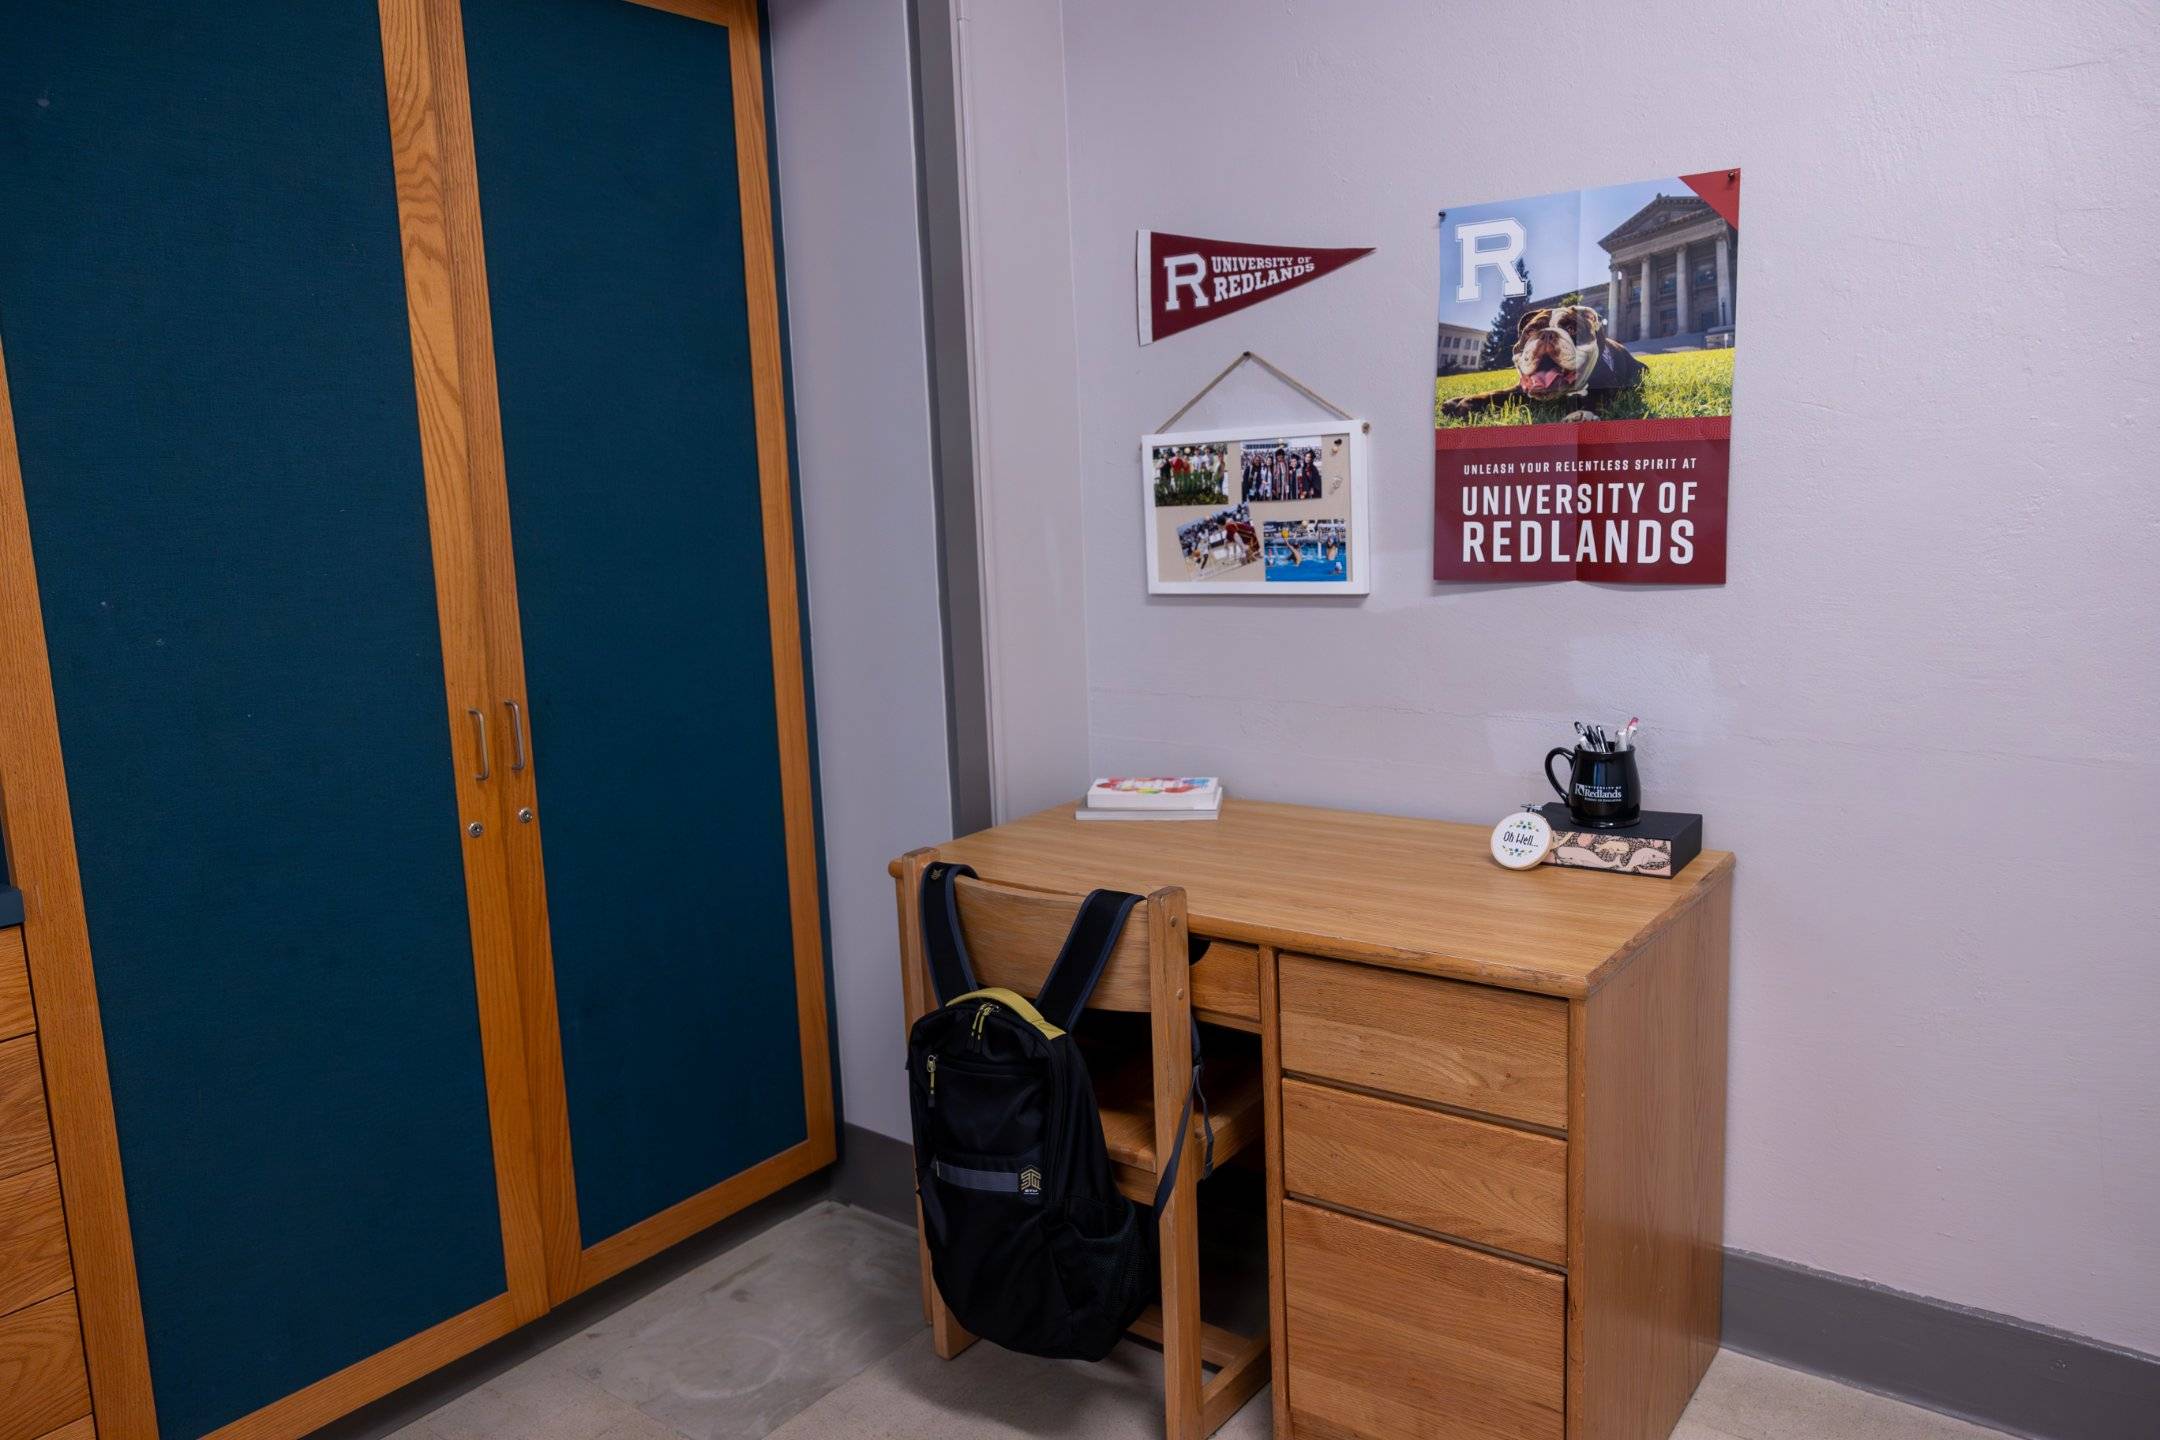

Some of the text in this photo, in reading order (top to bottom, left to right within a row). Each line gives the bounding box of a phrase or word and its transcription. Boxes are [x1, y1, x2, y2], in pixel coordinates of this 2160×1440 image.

[1211, 256, 1312, 273] UNIVERSITY OF
[1456, 217, 1527, 302] R
[1163, 253, 1209, 311] R
[1213, 263, 1315, 302] REDLANDS
[1463, 457, 1697, 475] UNLEASH YOUR RELENTLESS SPIRIT AT
[1462, 481, 1698, 516] UNIVERSITY OF
[1462, 519, 1695, 565] REDLANDS
[1584, 788, 1622, 799] Redlands
